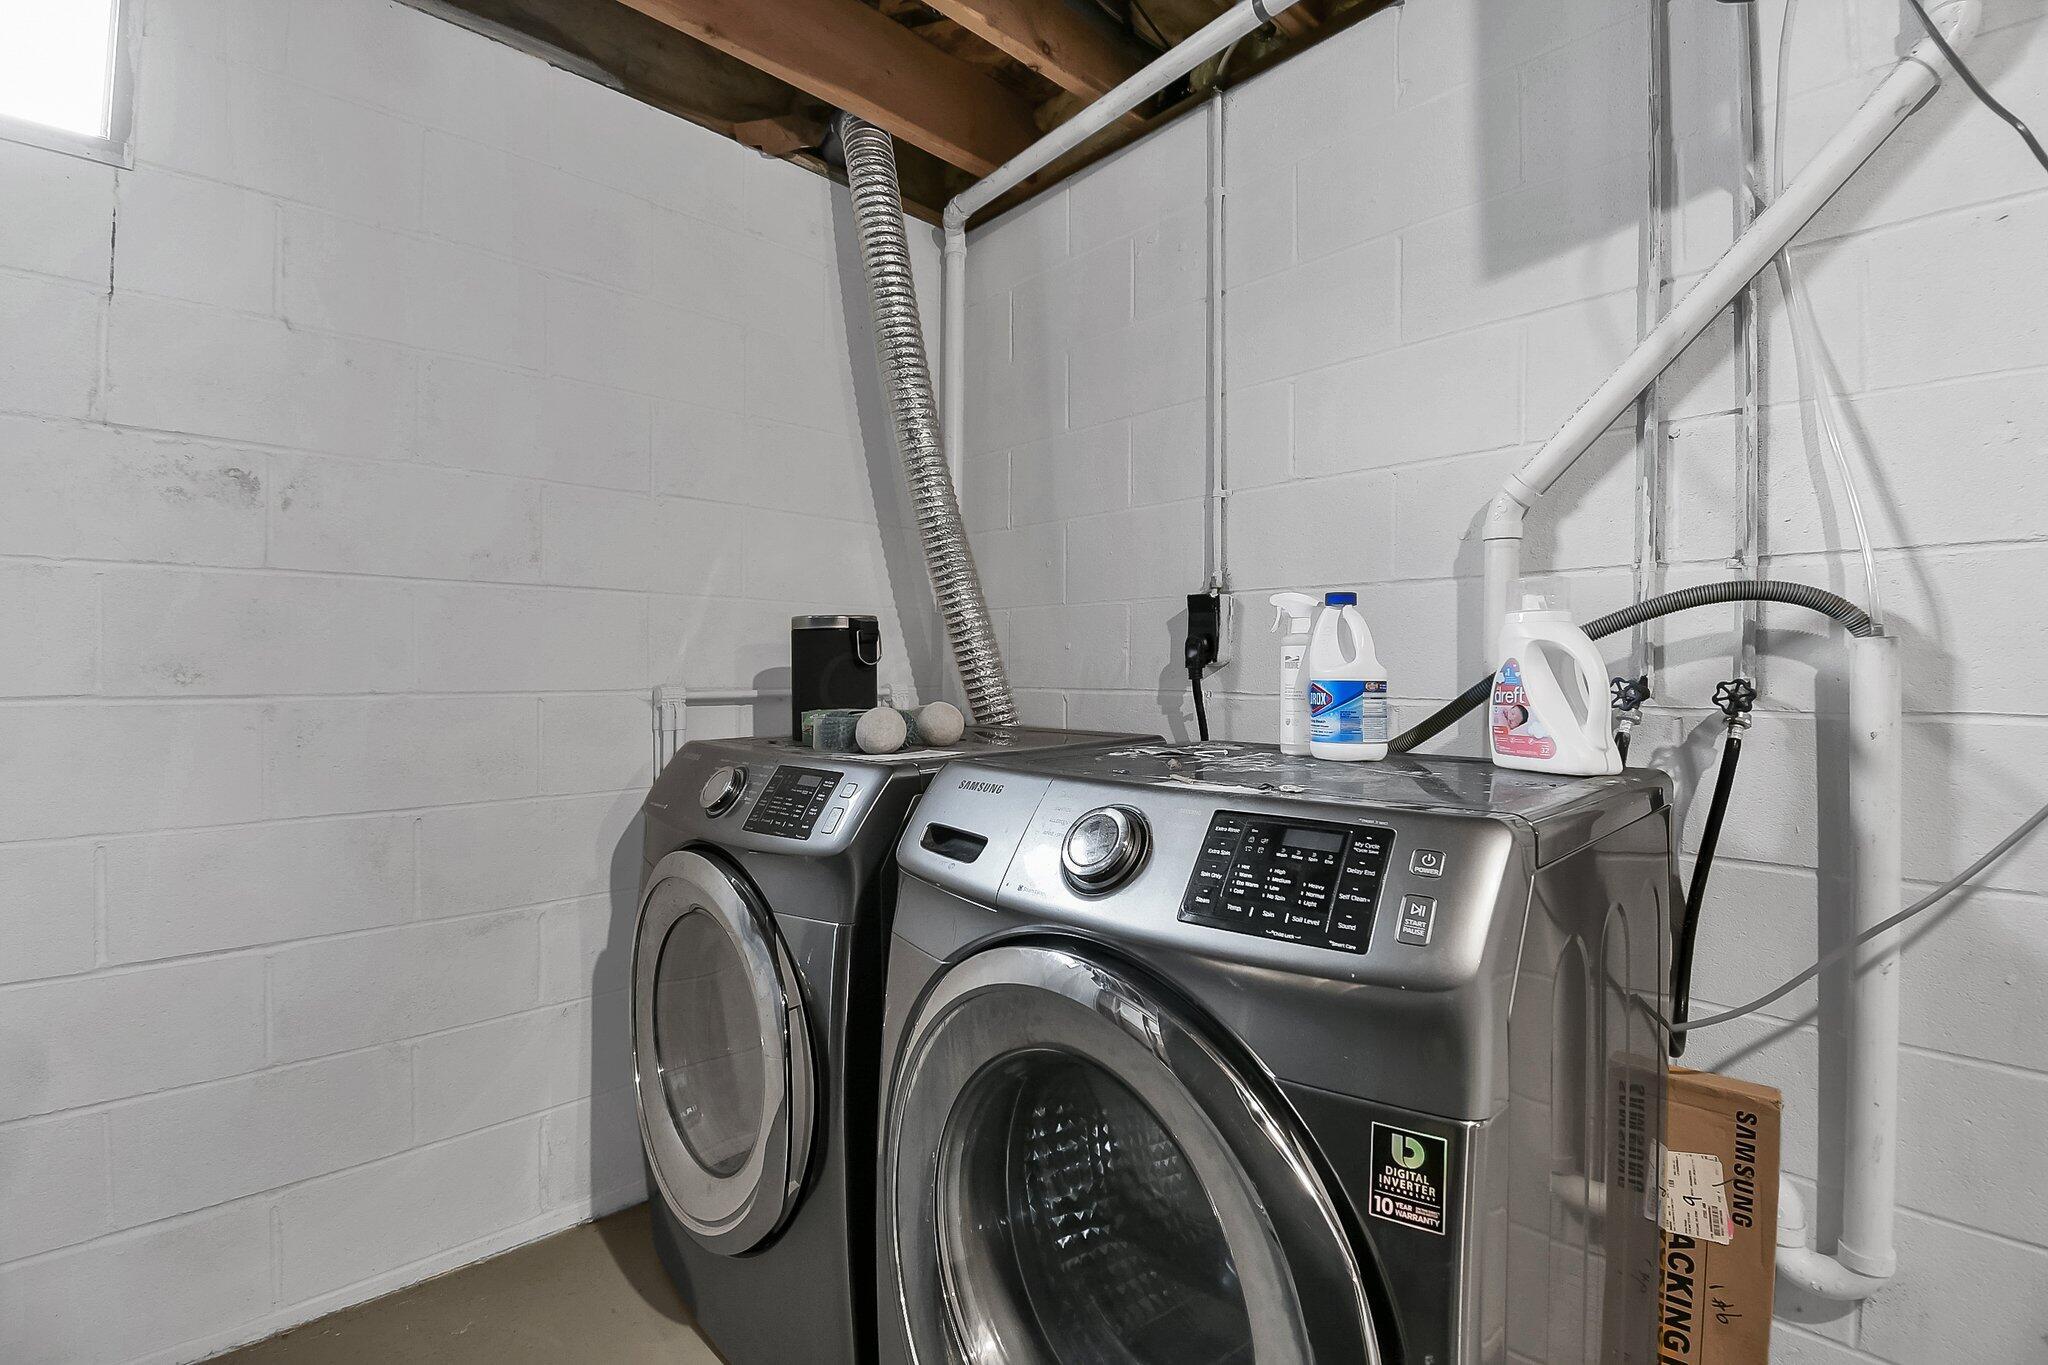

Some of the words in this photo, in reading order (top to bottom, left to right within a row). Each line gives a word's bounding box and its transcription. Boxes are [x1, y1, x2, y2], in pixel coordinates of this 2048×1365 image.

[1494, 686, 1525, 704] dreft
[958, 779, 1005, 794] SAMSUNG
[1211, 872, 1223, 880] Only
[1346, 867, 1363, 876] Delay
[1364, 869, 1376, 877] End
[1414, 866, 1439, 876] POWER
[1271, 877, 1292, 885] Medium
[1308, 883, 1325, 891] Heavy
[1305, 891, 1325, 900] Normal
[1338, 893, 1350, 901] Self
[1303, 900, 1318, 908] Light
[1262, 910, 1275, 918] Spin
[1292, 915, 1303, 923] Soil
[1303, 917, 1321, 927] Level
[1404, 919, 1427, 928] START
[1337, 922, 1357, 931] Sound
[1402, 927, 1426, 937] PAUSE
[1731, 1110, 1758, 1228] SAMSUNG
[1385, 1165, 1430, 1186] DIGITAL
[1378, 1174, 1436, 1198] INVERTER
[1373, 1195, 1394, 1215] 10
[1395, 1201, 1413, 1212] YEAR
[1394, 1208, 1441, 1228] WARRANTY
[1663, 1233, 1696, 1355] ACKING
